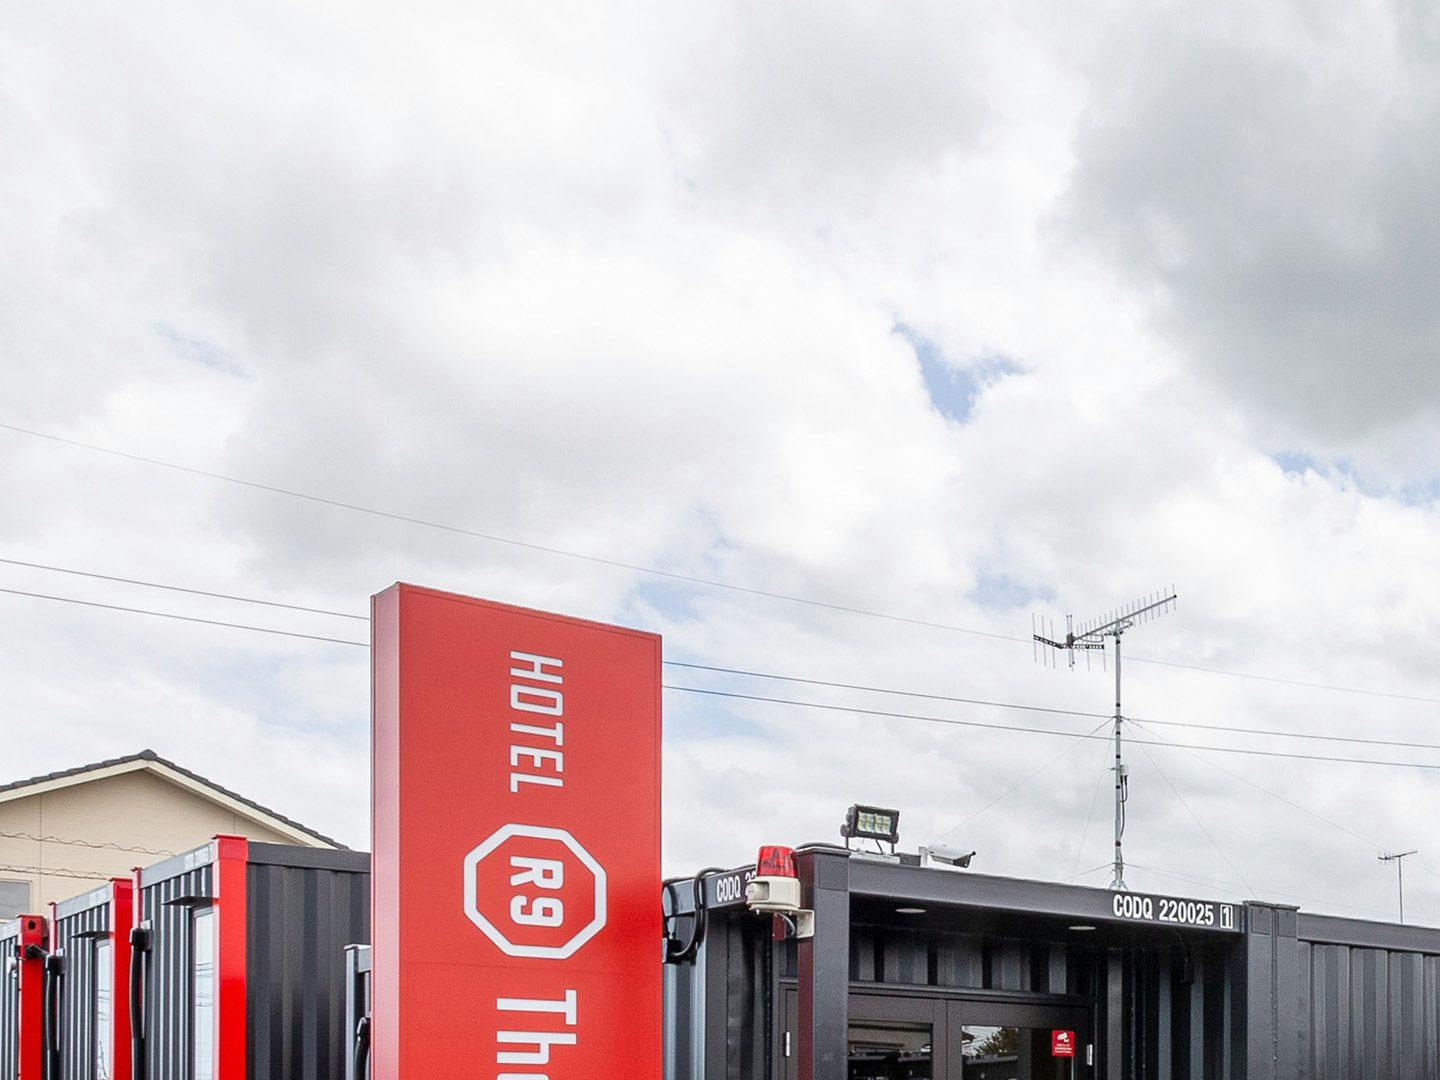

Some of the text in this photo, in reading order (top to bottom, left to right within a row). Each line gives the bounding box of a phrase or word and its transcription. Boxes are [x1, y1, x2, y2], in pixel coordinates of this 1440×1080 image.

[510, 650, 564, 793] HOTEL
[510, 856, 564, 928] R9
[716, 875, 741, 903] CODQ
[1113, 894, 1153, 920] CODQ
[1159, 899, 1214, 926] 220025
